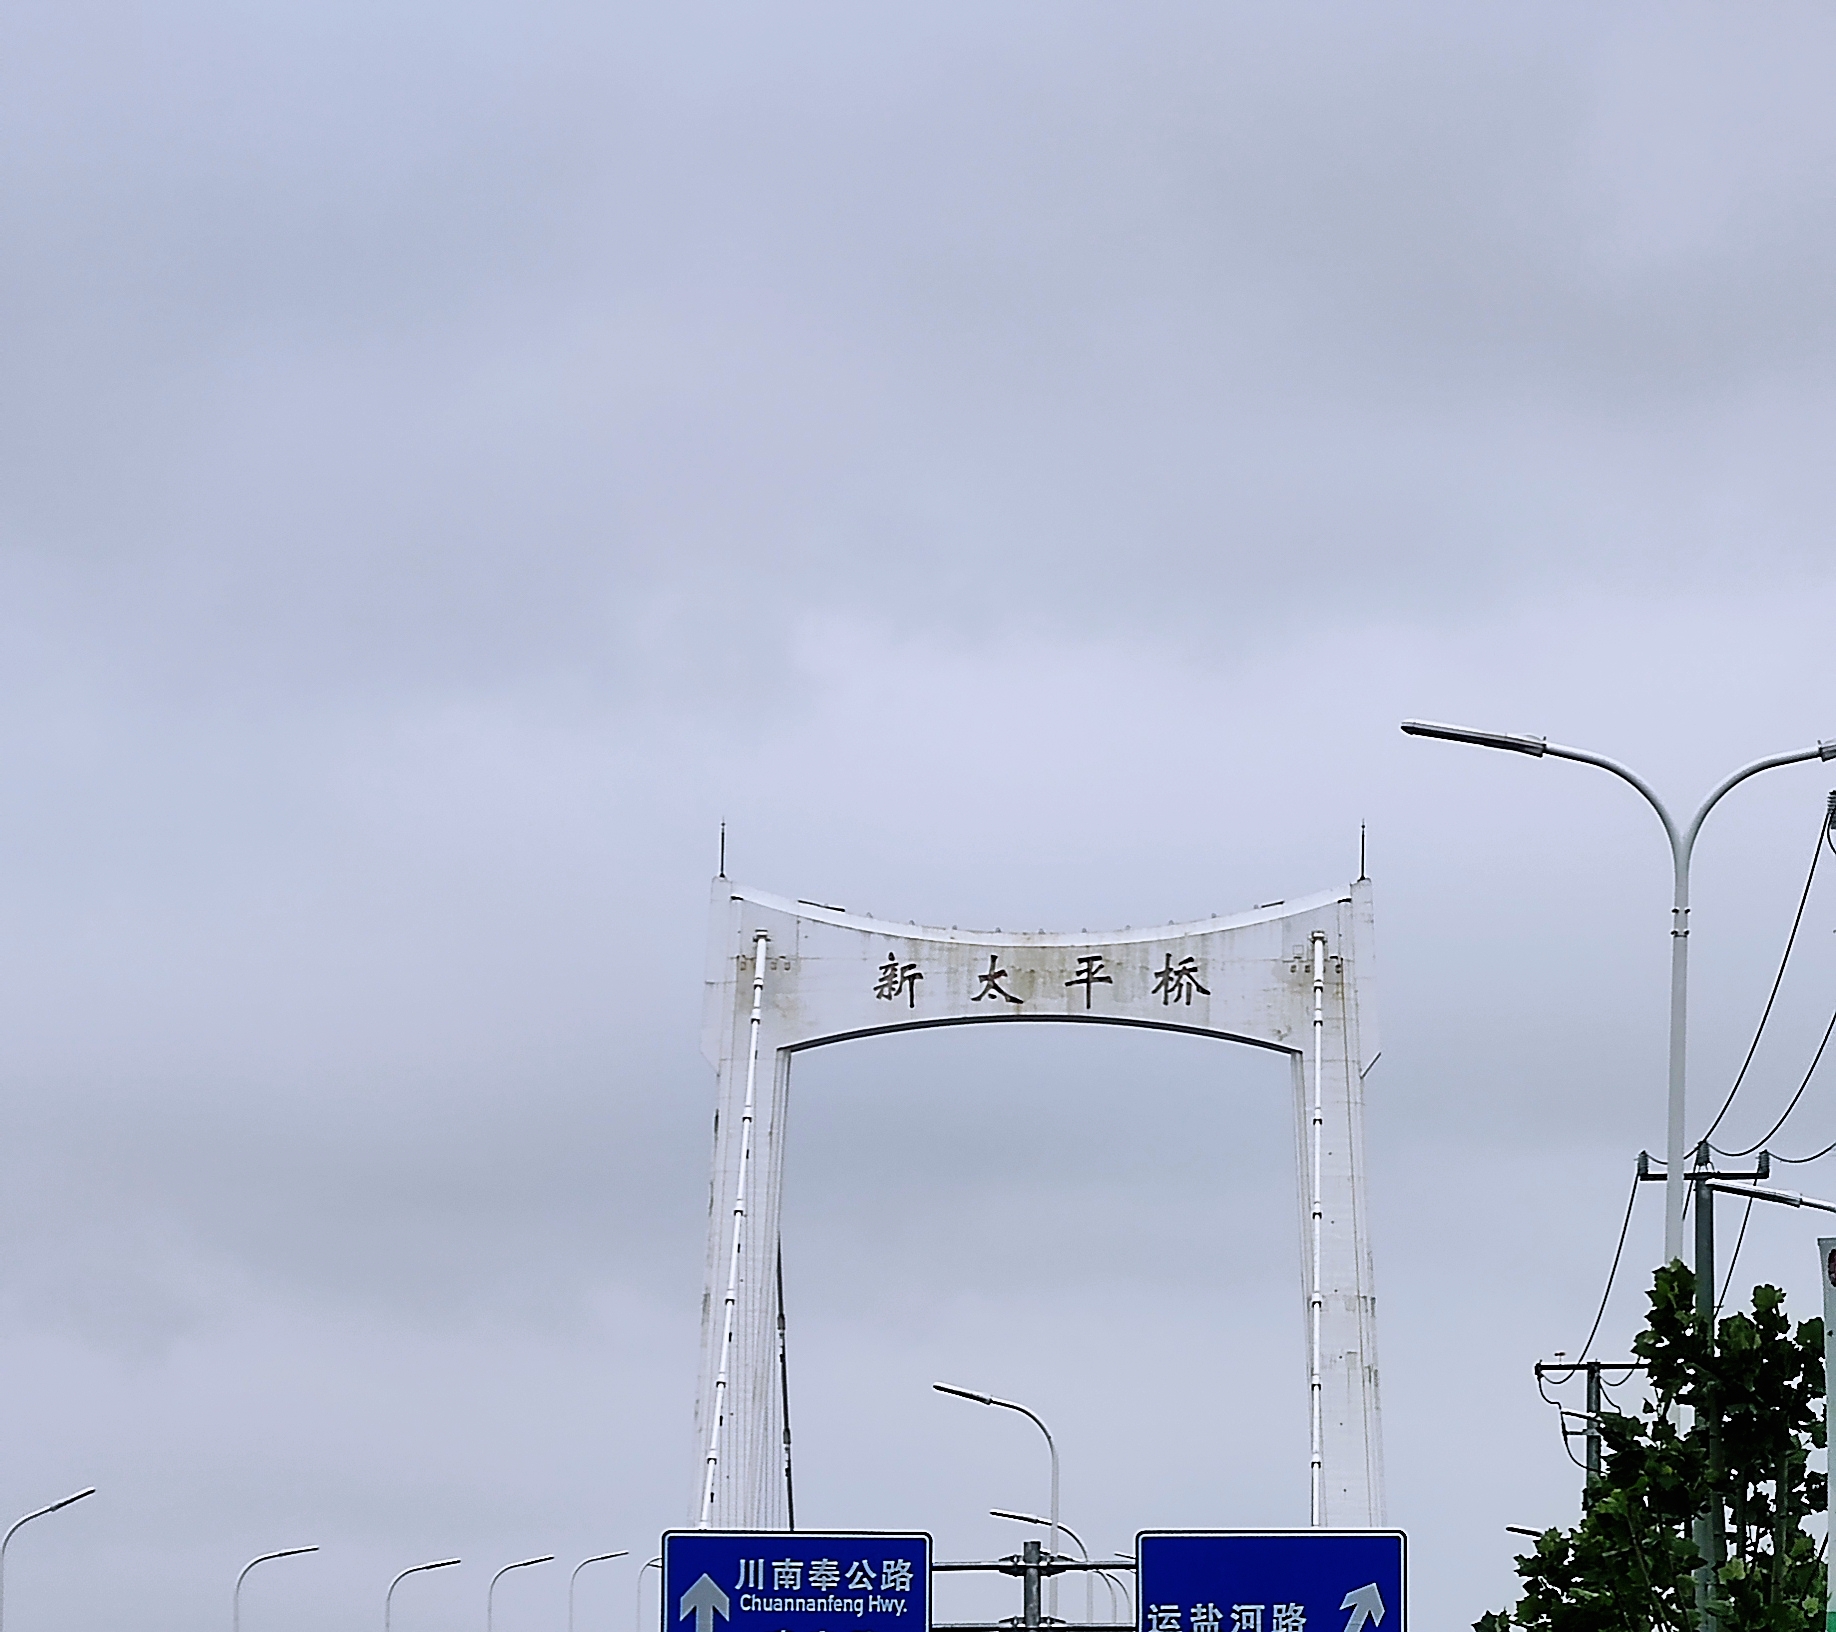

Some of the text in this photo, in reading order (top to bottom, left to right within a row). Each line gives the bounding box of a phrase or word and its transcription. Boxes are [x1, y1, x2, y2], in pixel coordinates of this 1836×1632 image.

[873, 951, 1211, 1010] 新太平桥
[734, 1558, 914, 1592] 川南奉公路
[740, 1594, 908, 1618] Chuannanfeng Hwy.
